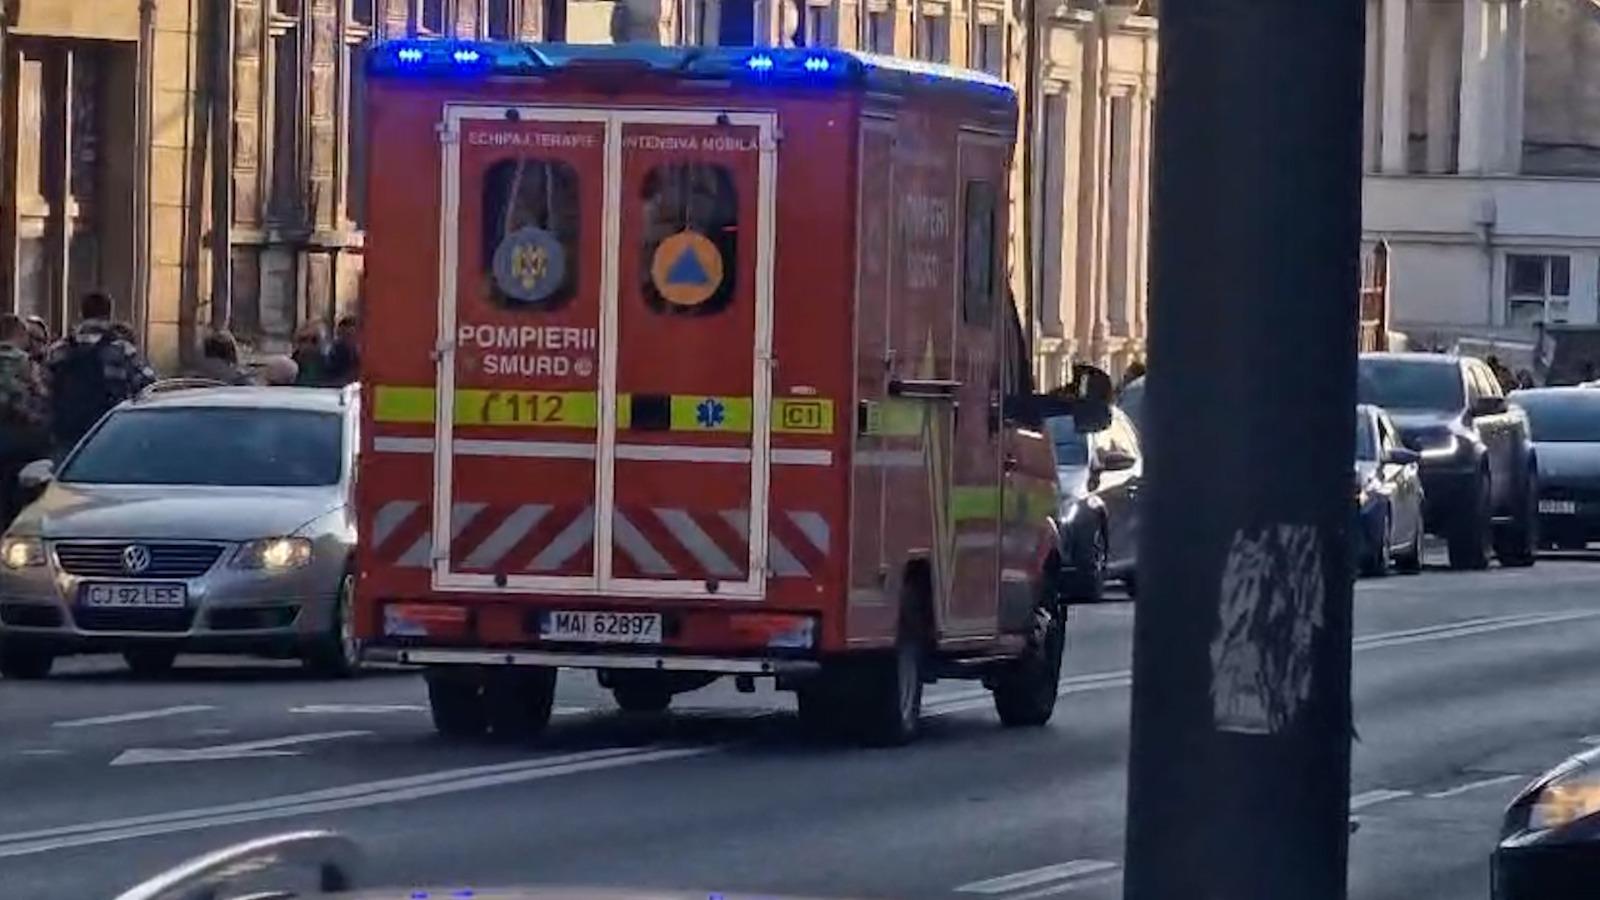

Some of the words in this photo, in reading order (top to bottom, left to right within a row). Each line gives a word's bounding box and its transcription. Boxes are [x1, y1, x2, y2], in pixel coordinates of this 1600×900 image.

[458, 324, 596, 350] POMPIERII
[482, 354, 569, 376] SMURD
[505, 393, 564, 423] 112
[91, 587, 113, 604] CJ
[144, 586, 181, 605] LEE
[556, 613, 586, 634] MAI
[594, 615, 656, 635] 62897
